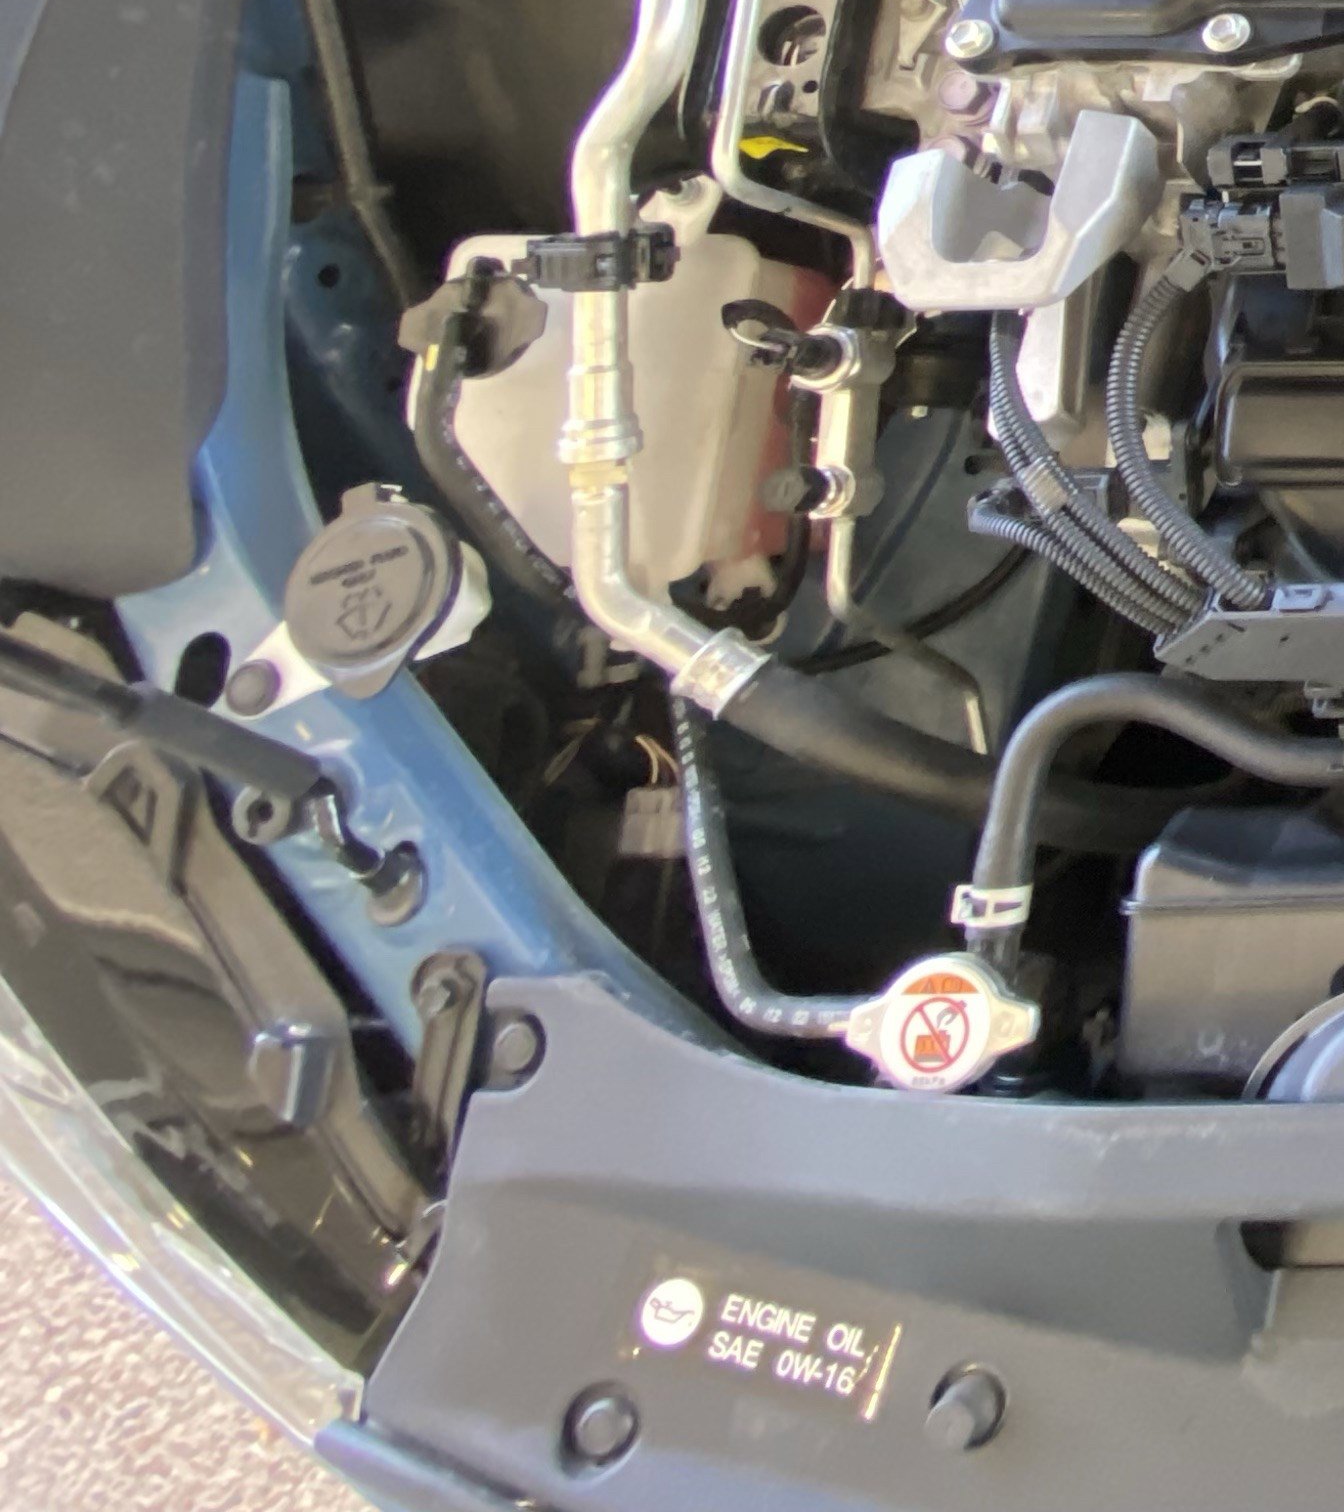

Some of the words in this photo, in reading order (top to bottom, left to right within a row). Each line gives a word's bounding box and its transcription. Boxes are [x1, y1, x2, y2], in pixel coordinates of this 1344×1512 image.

[720, 1293, 816, 1344] ENGINE
[826, 1323, 866, 1358] OIL
[707, 1331, 764, 1370] SAE
[775, 1350, 855, 1396] 0W-16
